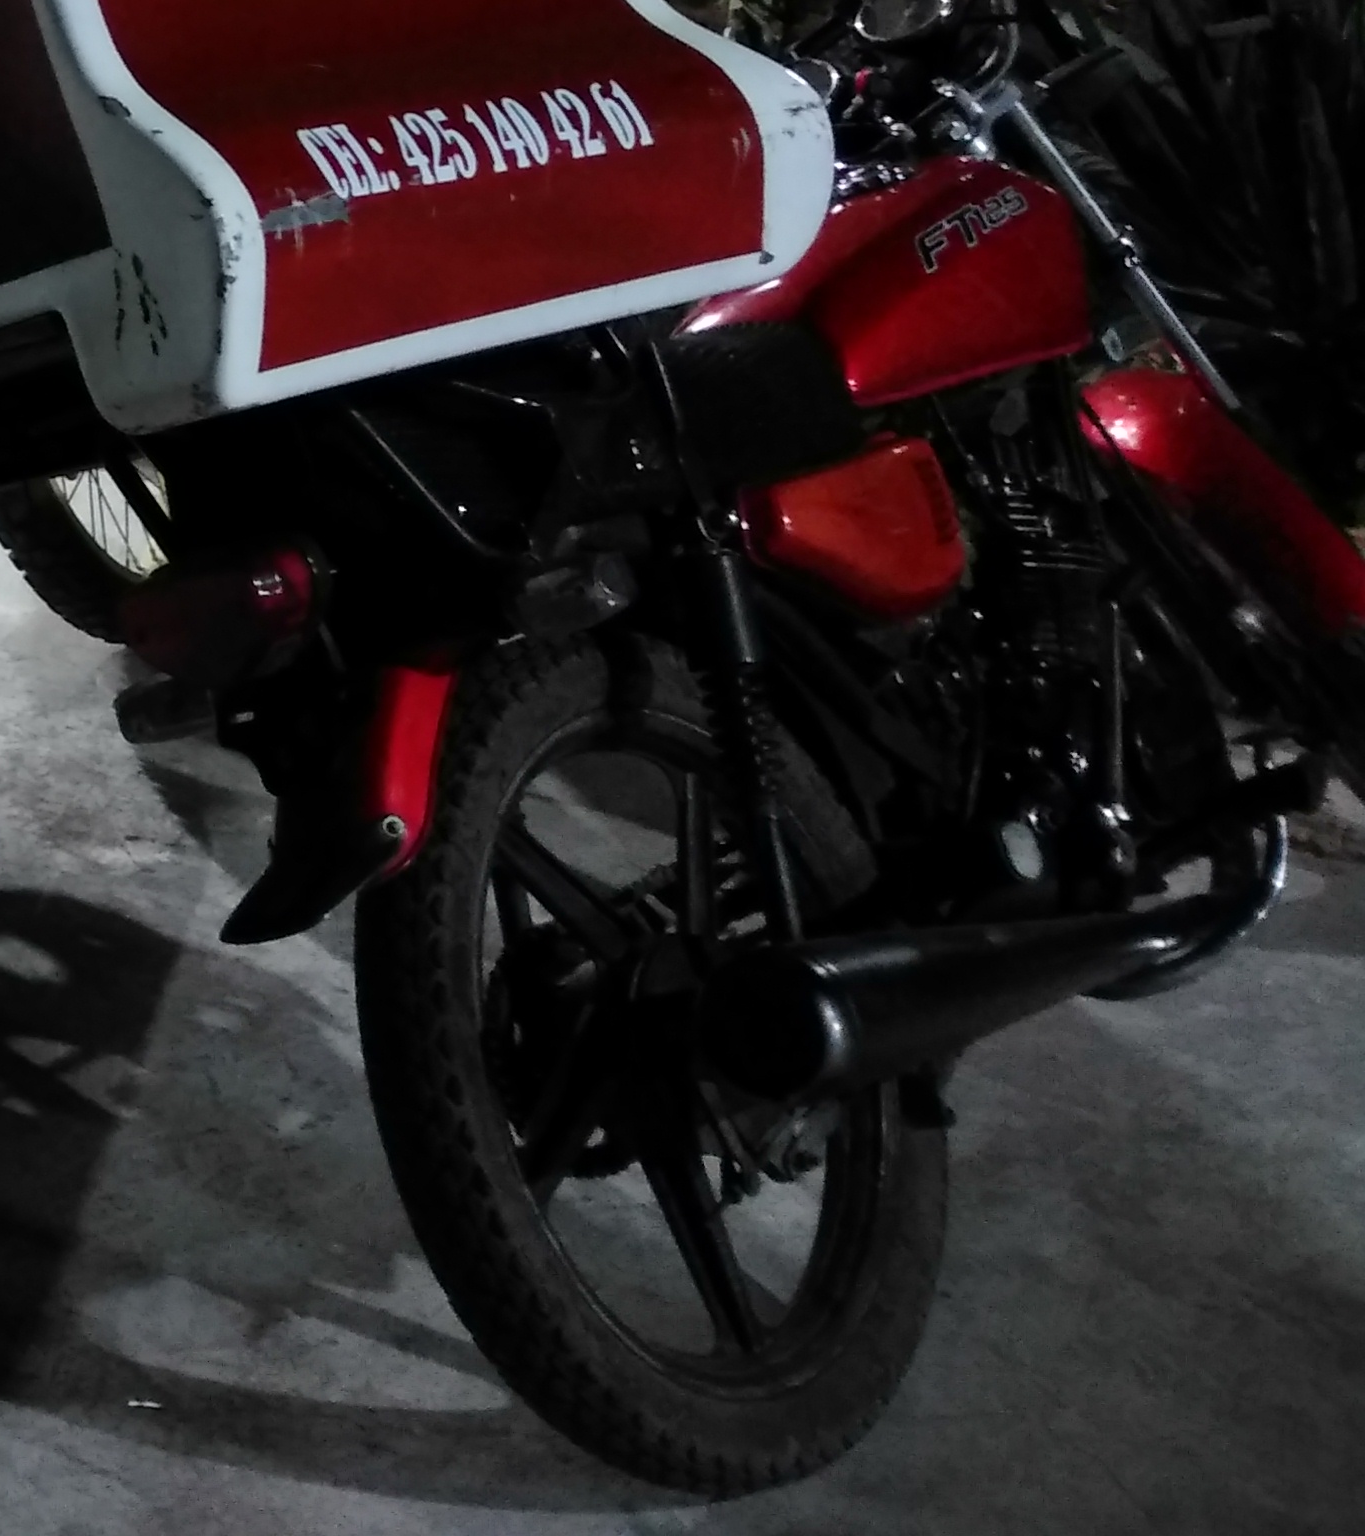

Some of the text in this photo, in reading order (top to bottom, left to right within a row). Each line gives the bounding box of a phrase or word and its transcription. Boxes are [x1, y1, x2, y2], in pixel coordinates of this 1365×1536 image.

[296, 79, 654, 199] CEL: 425 140 42 61
